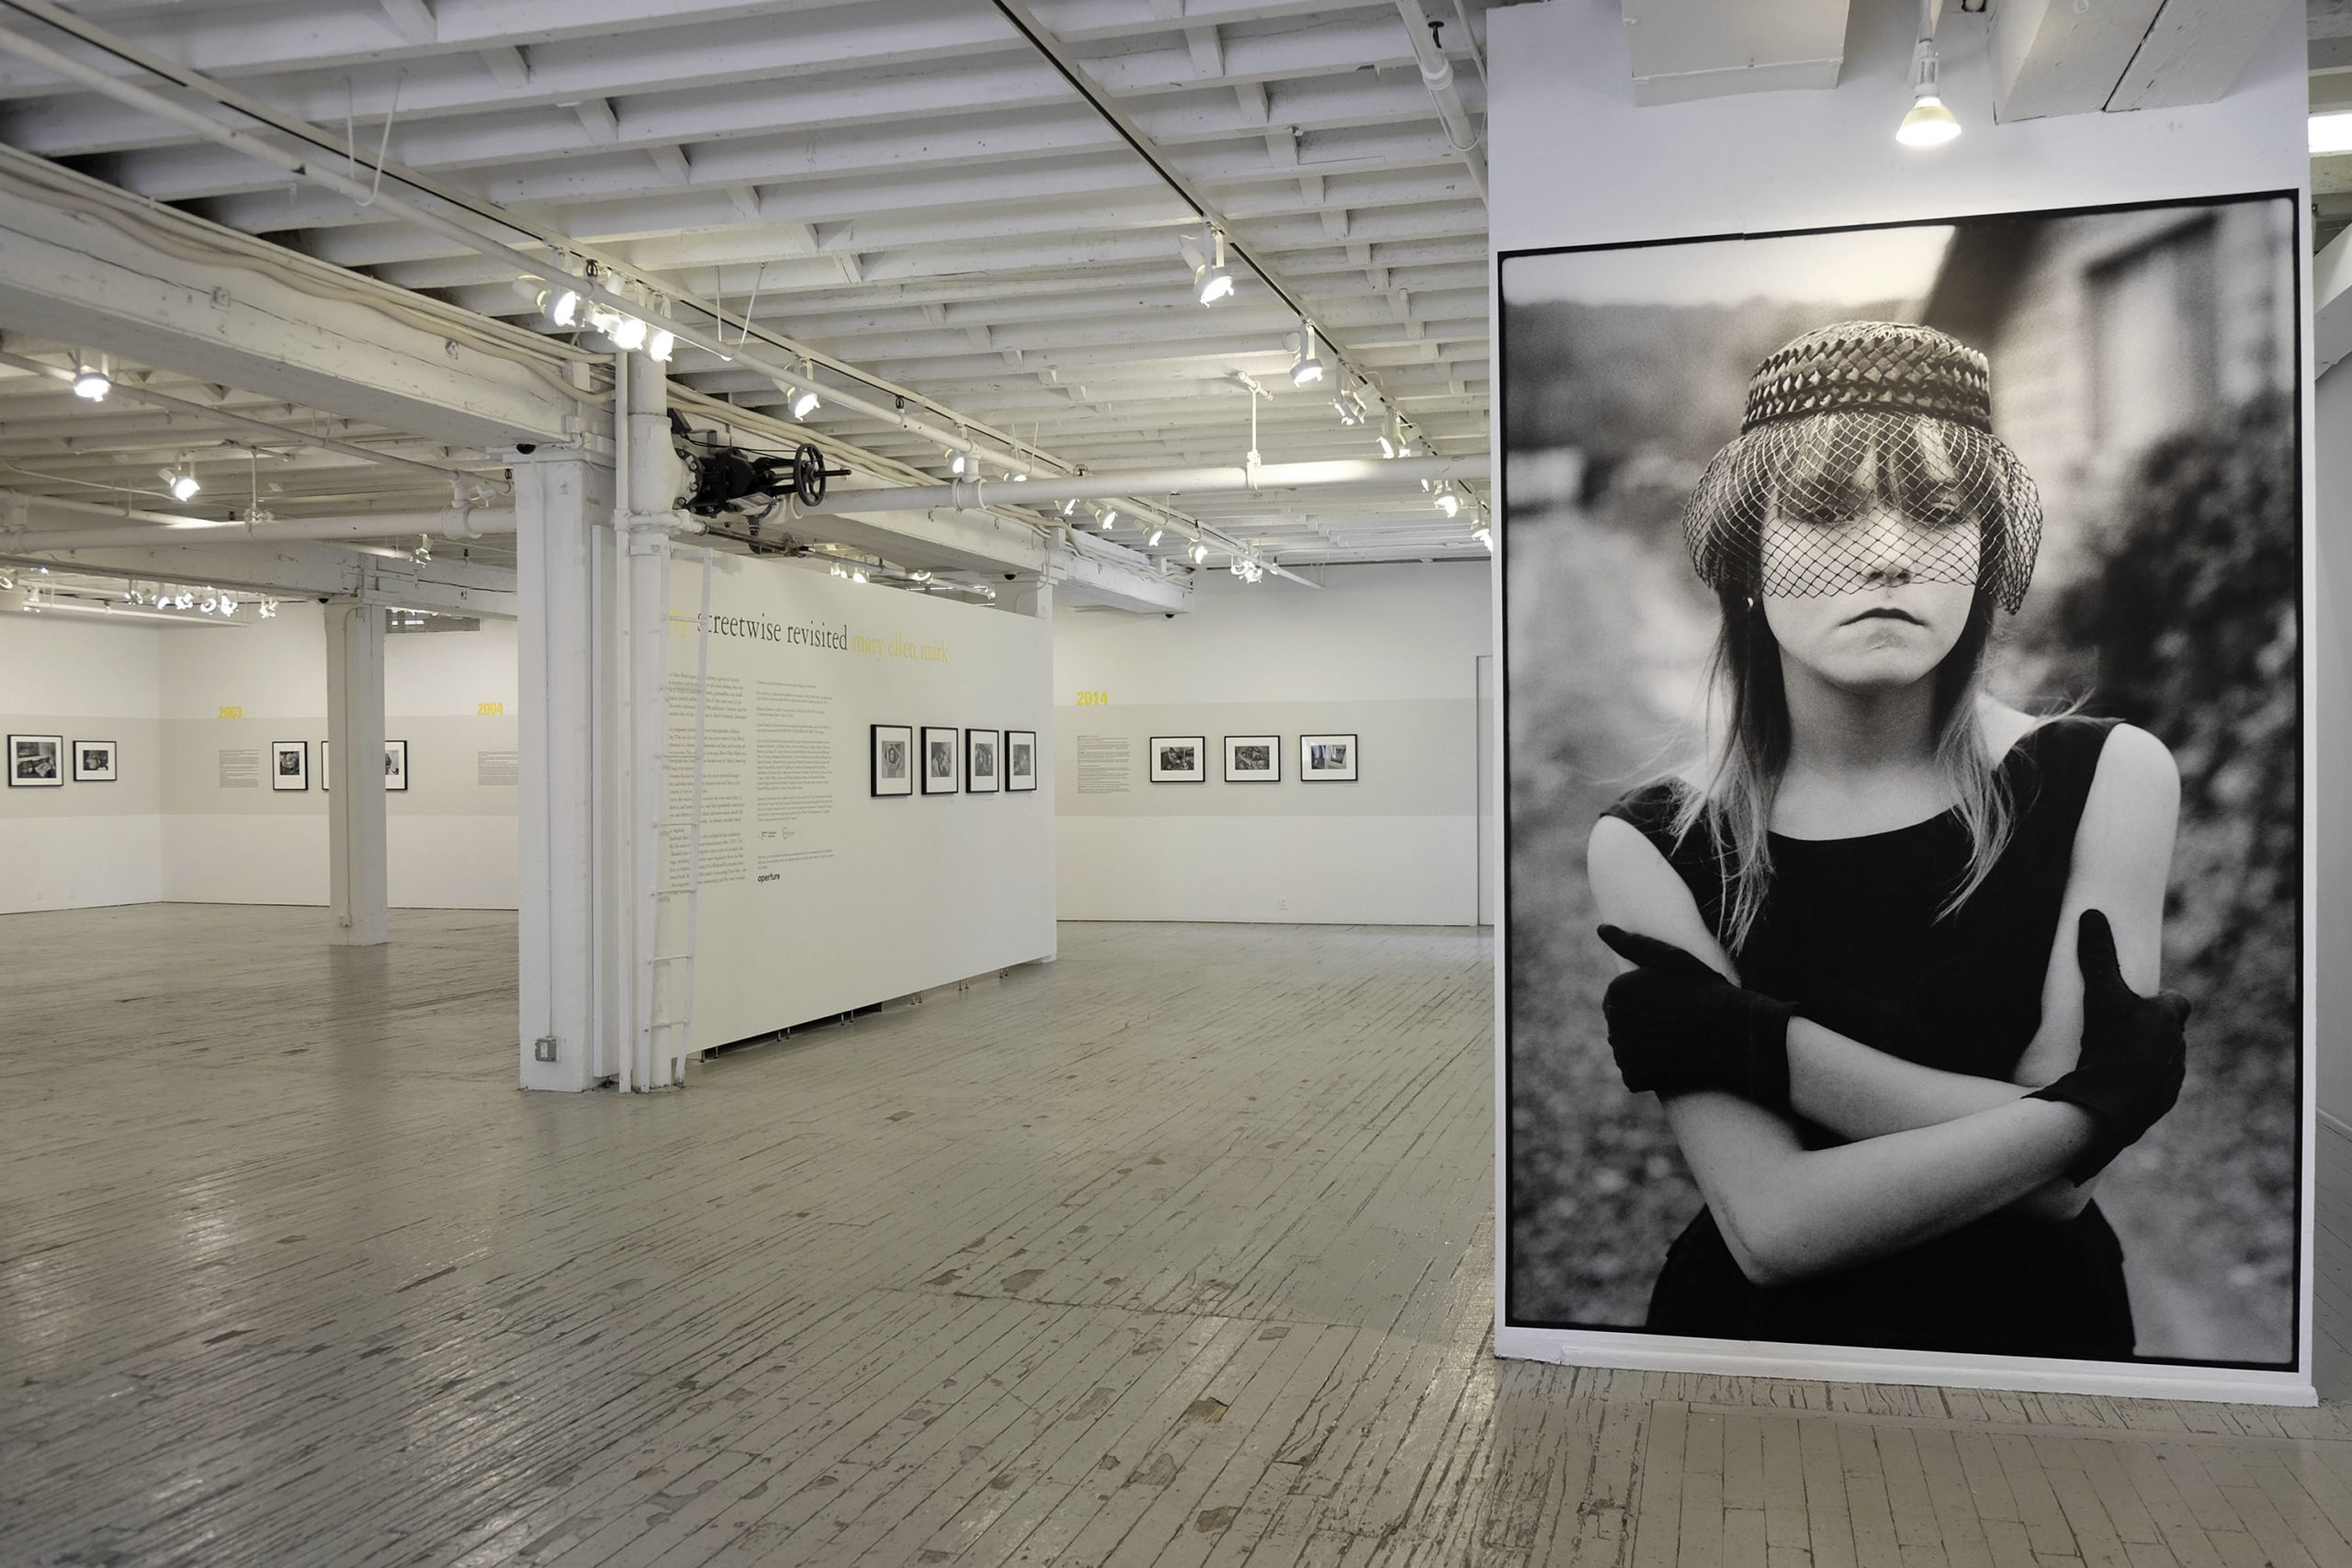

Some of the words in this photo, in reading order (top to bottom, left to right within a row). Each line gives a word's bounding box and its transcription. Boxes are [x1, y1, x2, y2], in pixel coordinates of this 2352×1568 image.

[786, 620, 848, 651] revisited
[852, 634, 885, 662] mary
[888, 633, 917, 659] ellen
[920, 638, 948, 662] mark
[1077, 691, 1108, 706] 2014
[218, 705, 243, 719] 2003
[477, 702, 503, 716] 2004
[757, 872, 781, 885] aperture
